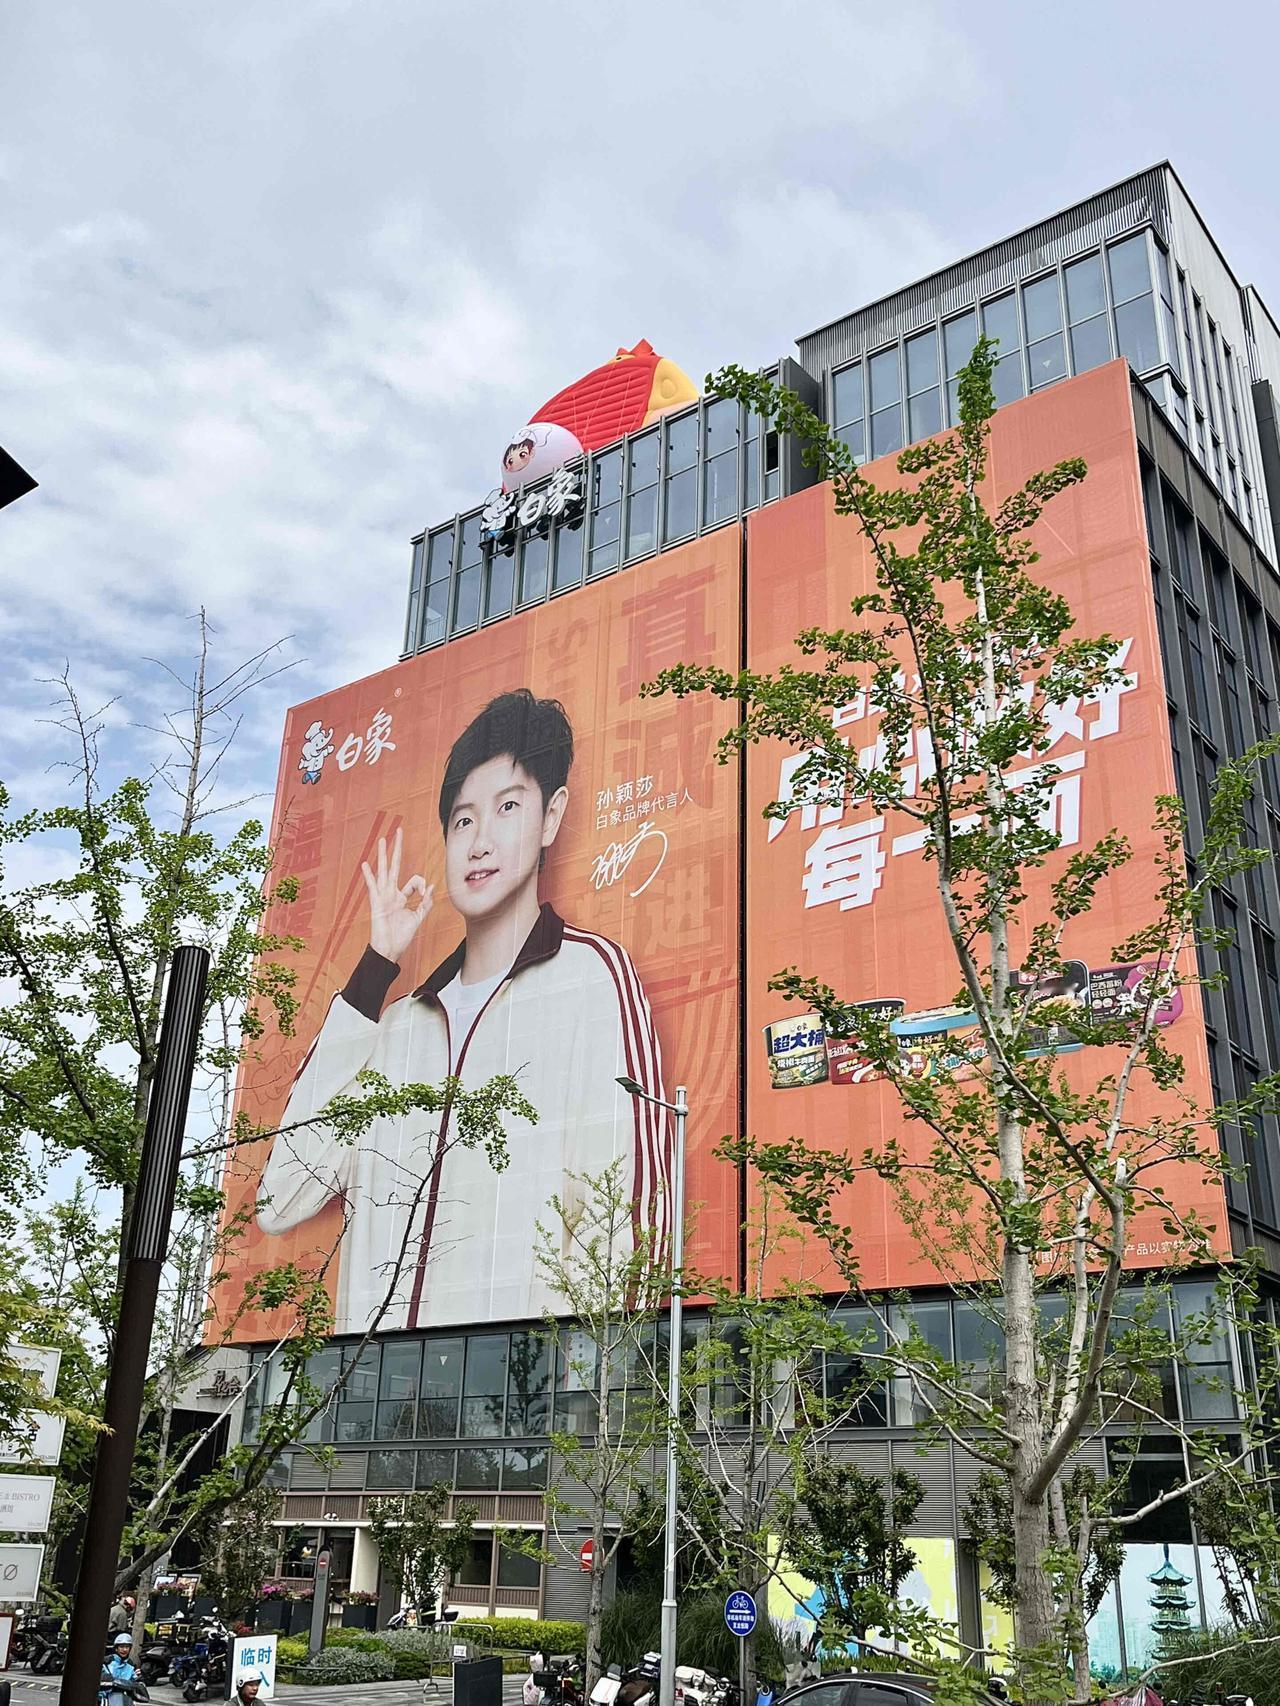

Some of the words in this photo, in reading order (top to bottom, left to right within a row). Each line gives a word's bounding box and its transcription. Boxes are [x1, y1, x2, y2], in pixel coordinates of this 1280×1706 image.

[517, 467, 581, 526] 白象
[335, 707, 396, 771] 白象
[596, 775, 653, 811] 孙颖莎
[596, 787, 693, 830] 白象品牌代言人
[773, 1029, 825, 1053] 超大桶
[12, 1492, 40, 1501] BISTRO
[240, 1646, 272, 1667] 临时
